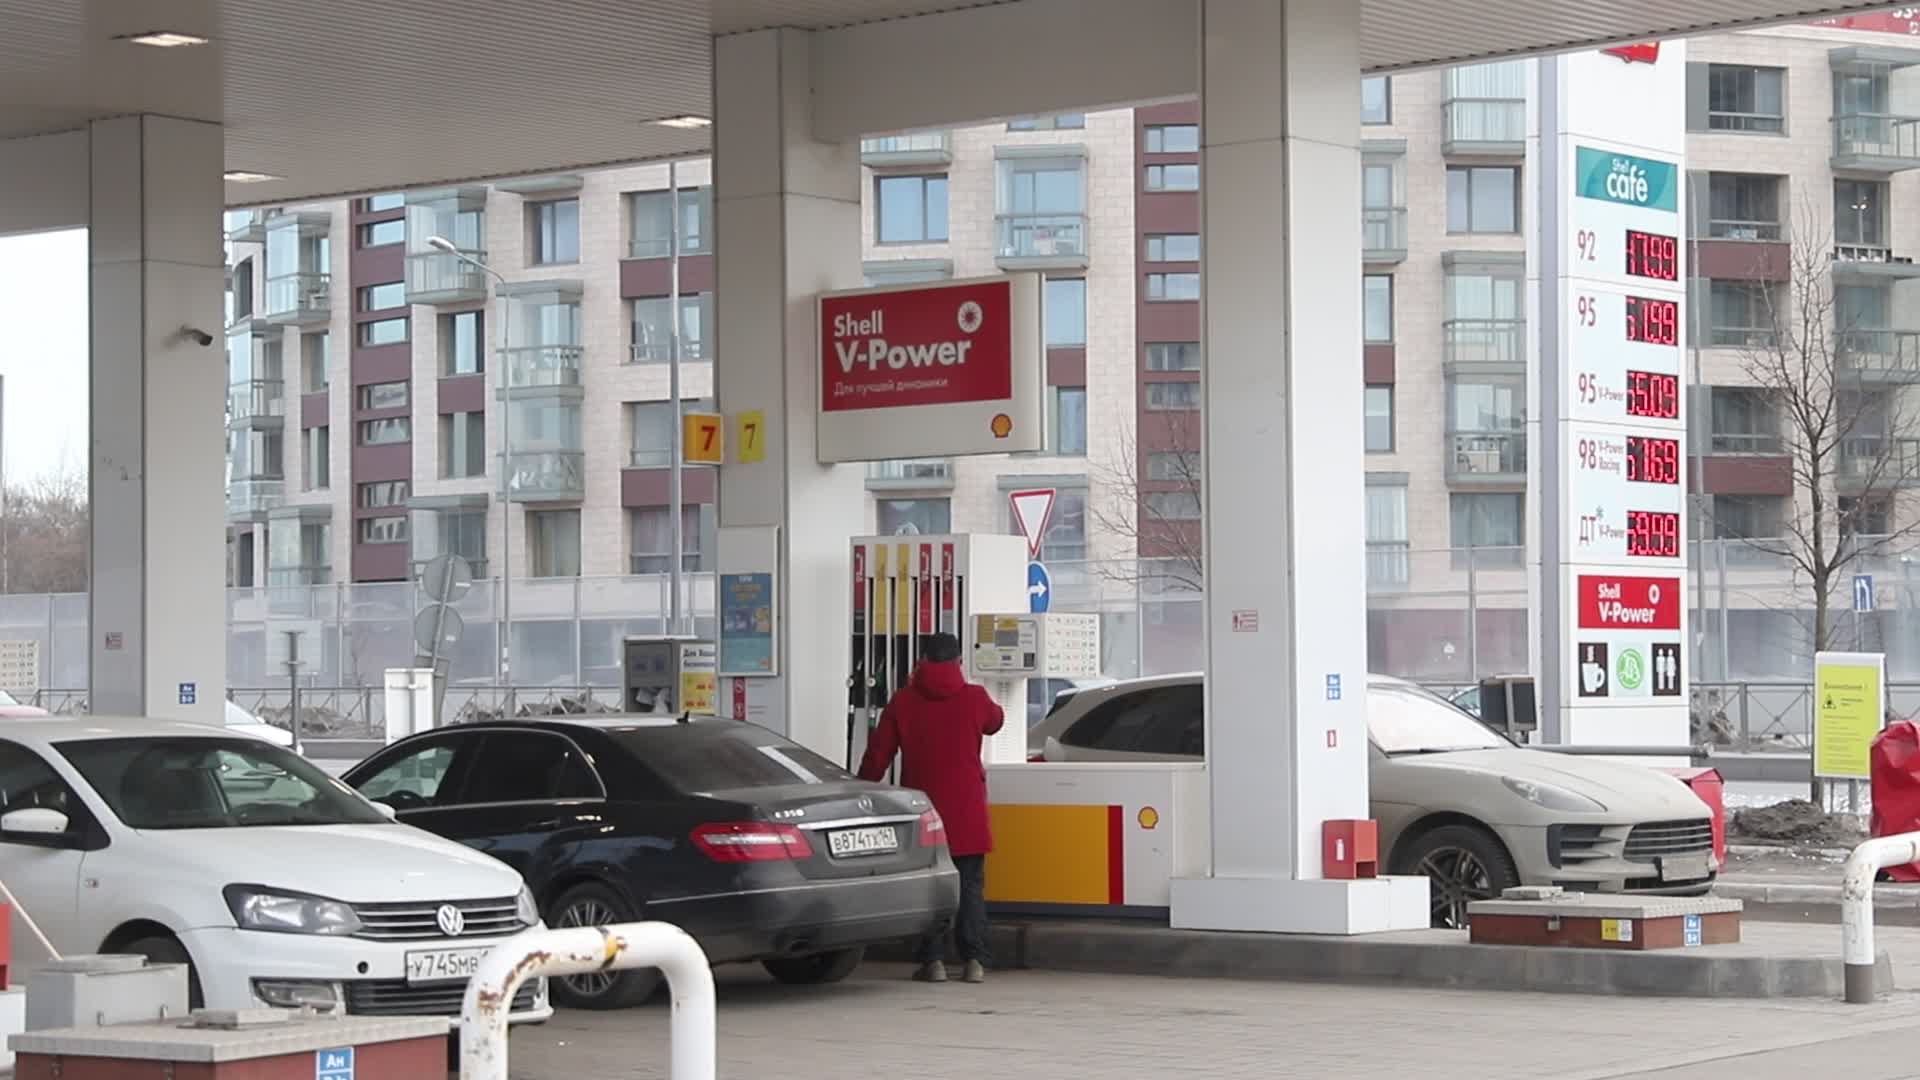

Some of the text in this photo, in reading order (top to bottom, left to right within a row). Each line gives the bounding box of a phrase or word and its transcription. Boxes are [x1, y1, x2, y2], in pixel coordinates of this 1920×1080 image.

[1607, 169, 1648, 202] café
[1577, 231, 1596, 261] 92
[833, 309, 883, 338] Shell
[1577, 296, 1597, 327] 95
[833, 338, 972, 373] V-Power
[1578, 373, 1597, 404] 95
[701, 425, 718, 452] 7
[744, 423, 756, 449] 7
[1578, 438, 1597, 470] 98
[1597, 583, 1621, 599] Shell
[1598, 601, 1656, 623] V-Power
